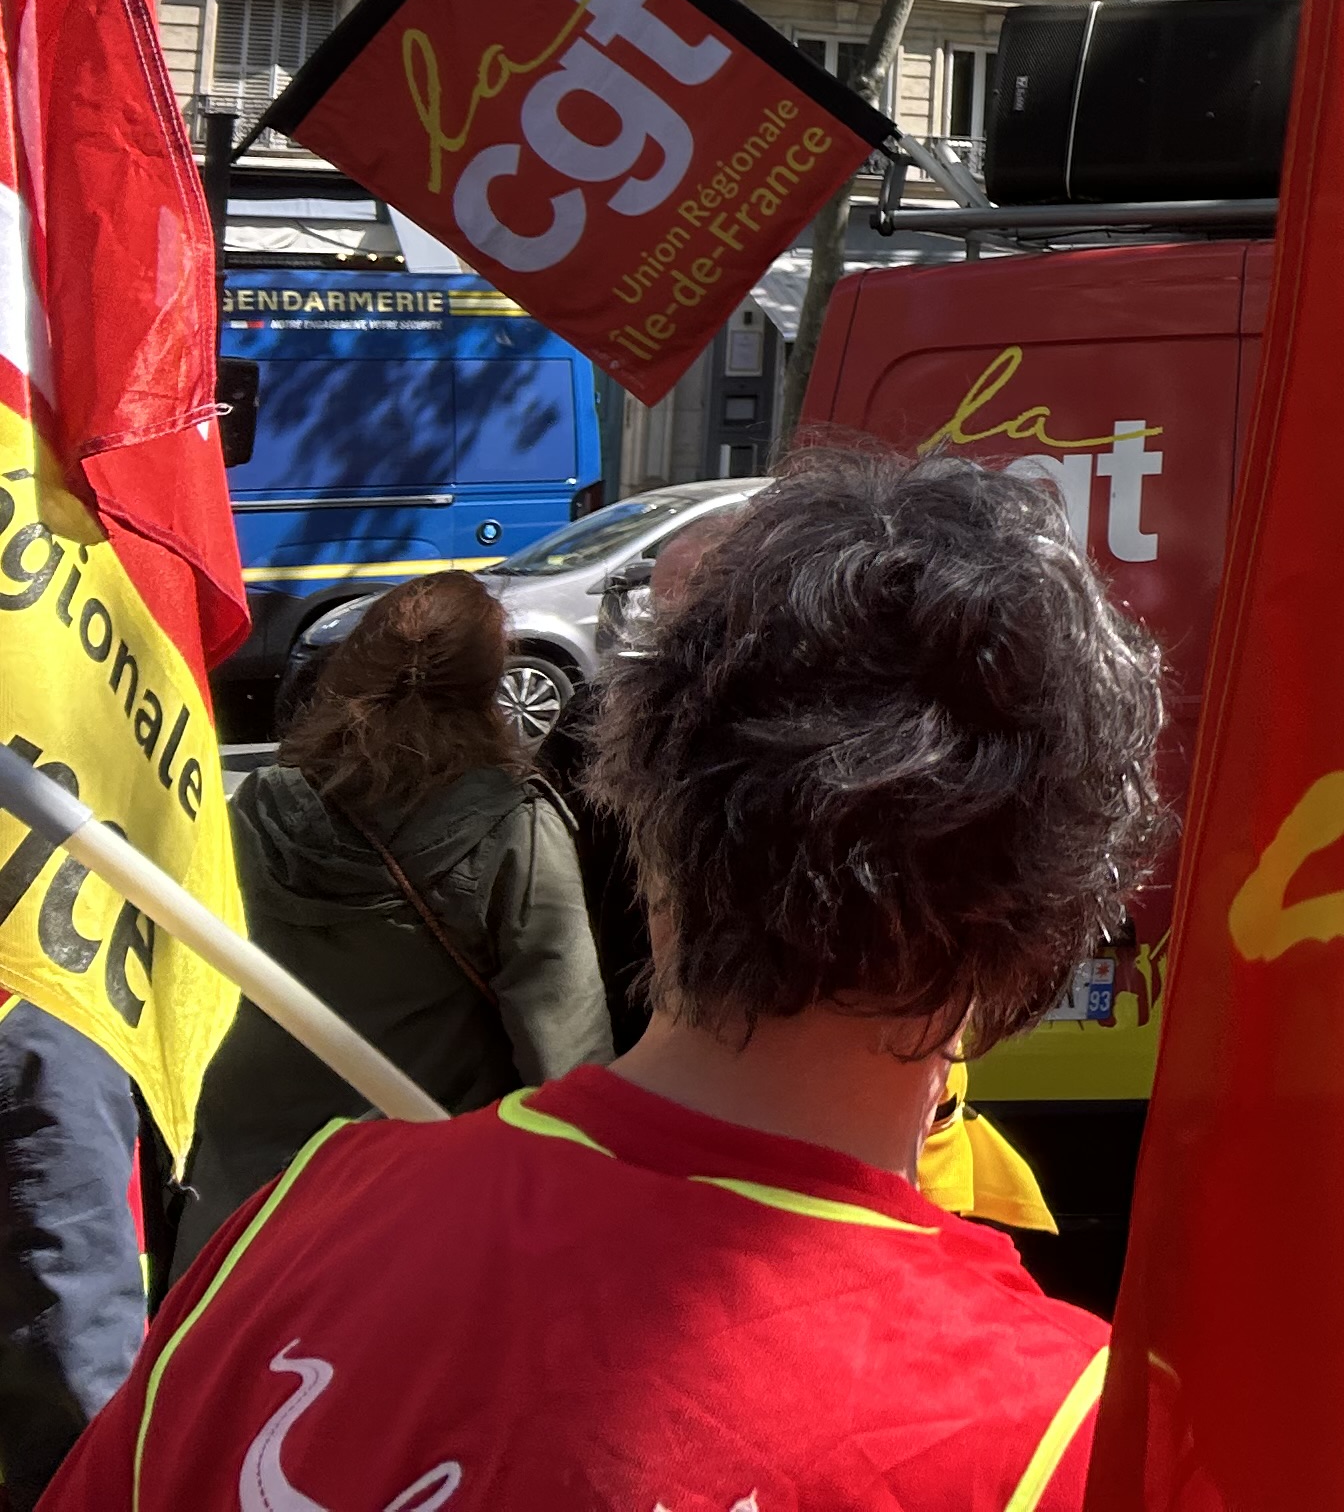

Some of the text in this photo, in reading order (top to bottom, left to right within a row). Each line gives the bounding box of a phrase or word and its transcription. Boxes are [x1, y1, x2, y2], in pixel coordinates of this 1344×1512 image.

[608, 124, 834, 362] Île-de-France
[613, 221, 692, 306] Union
[677, 96, 800, 229] Régionale
[917, 345, 1163, 456] la
[1089, 990, 1111, 1012] 93
